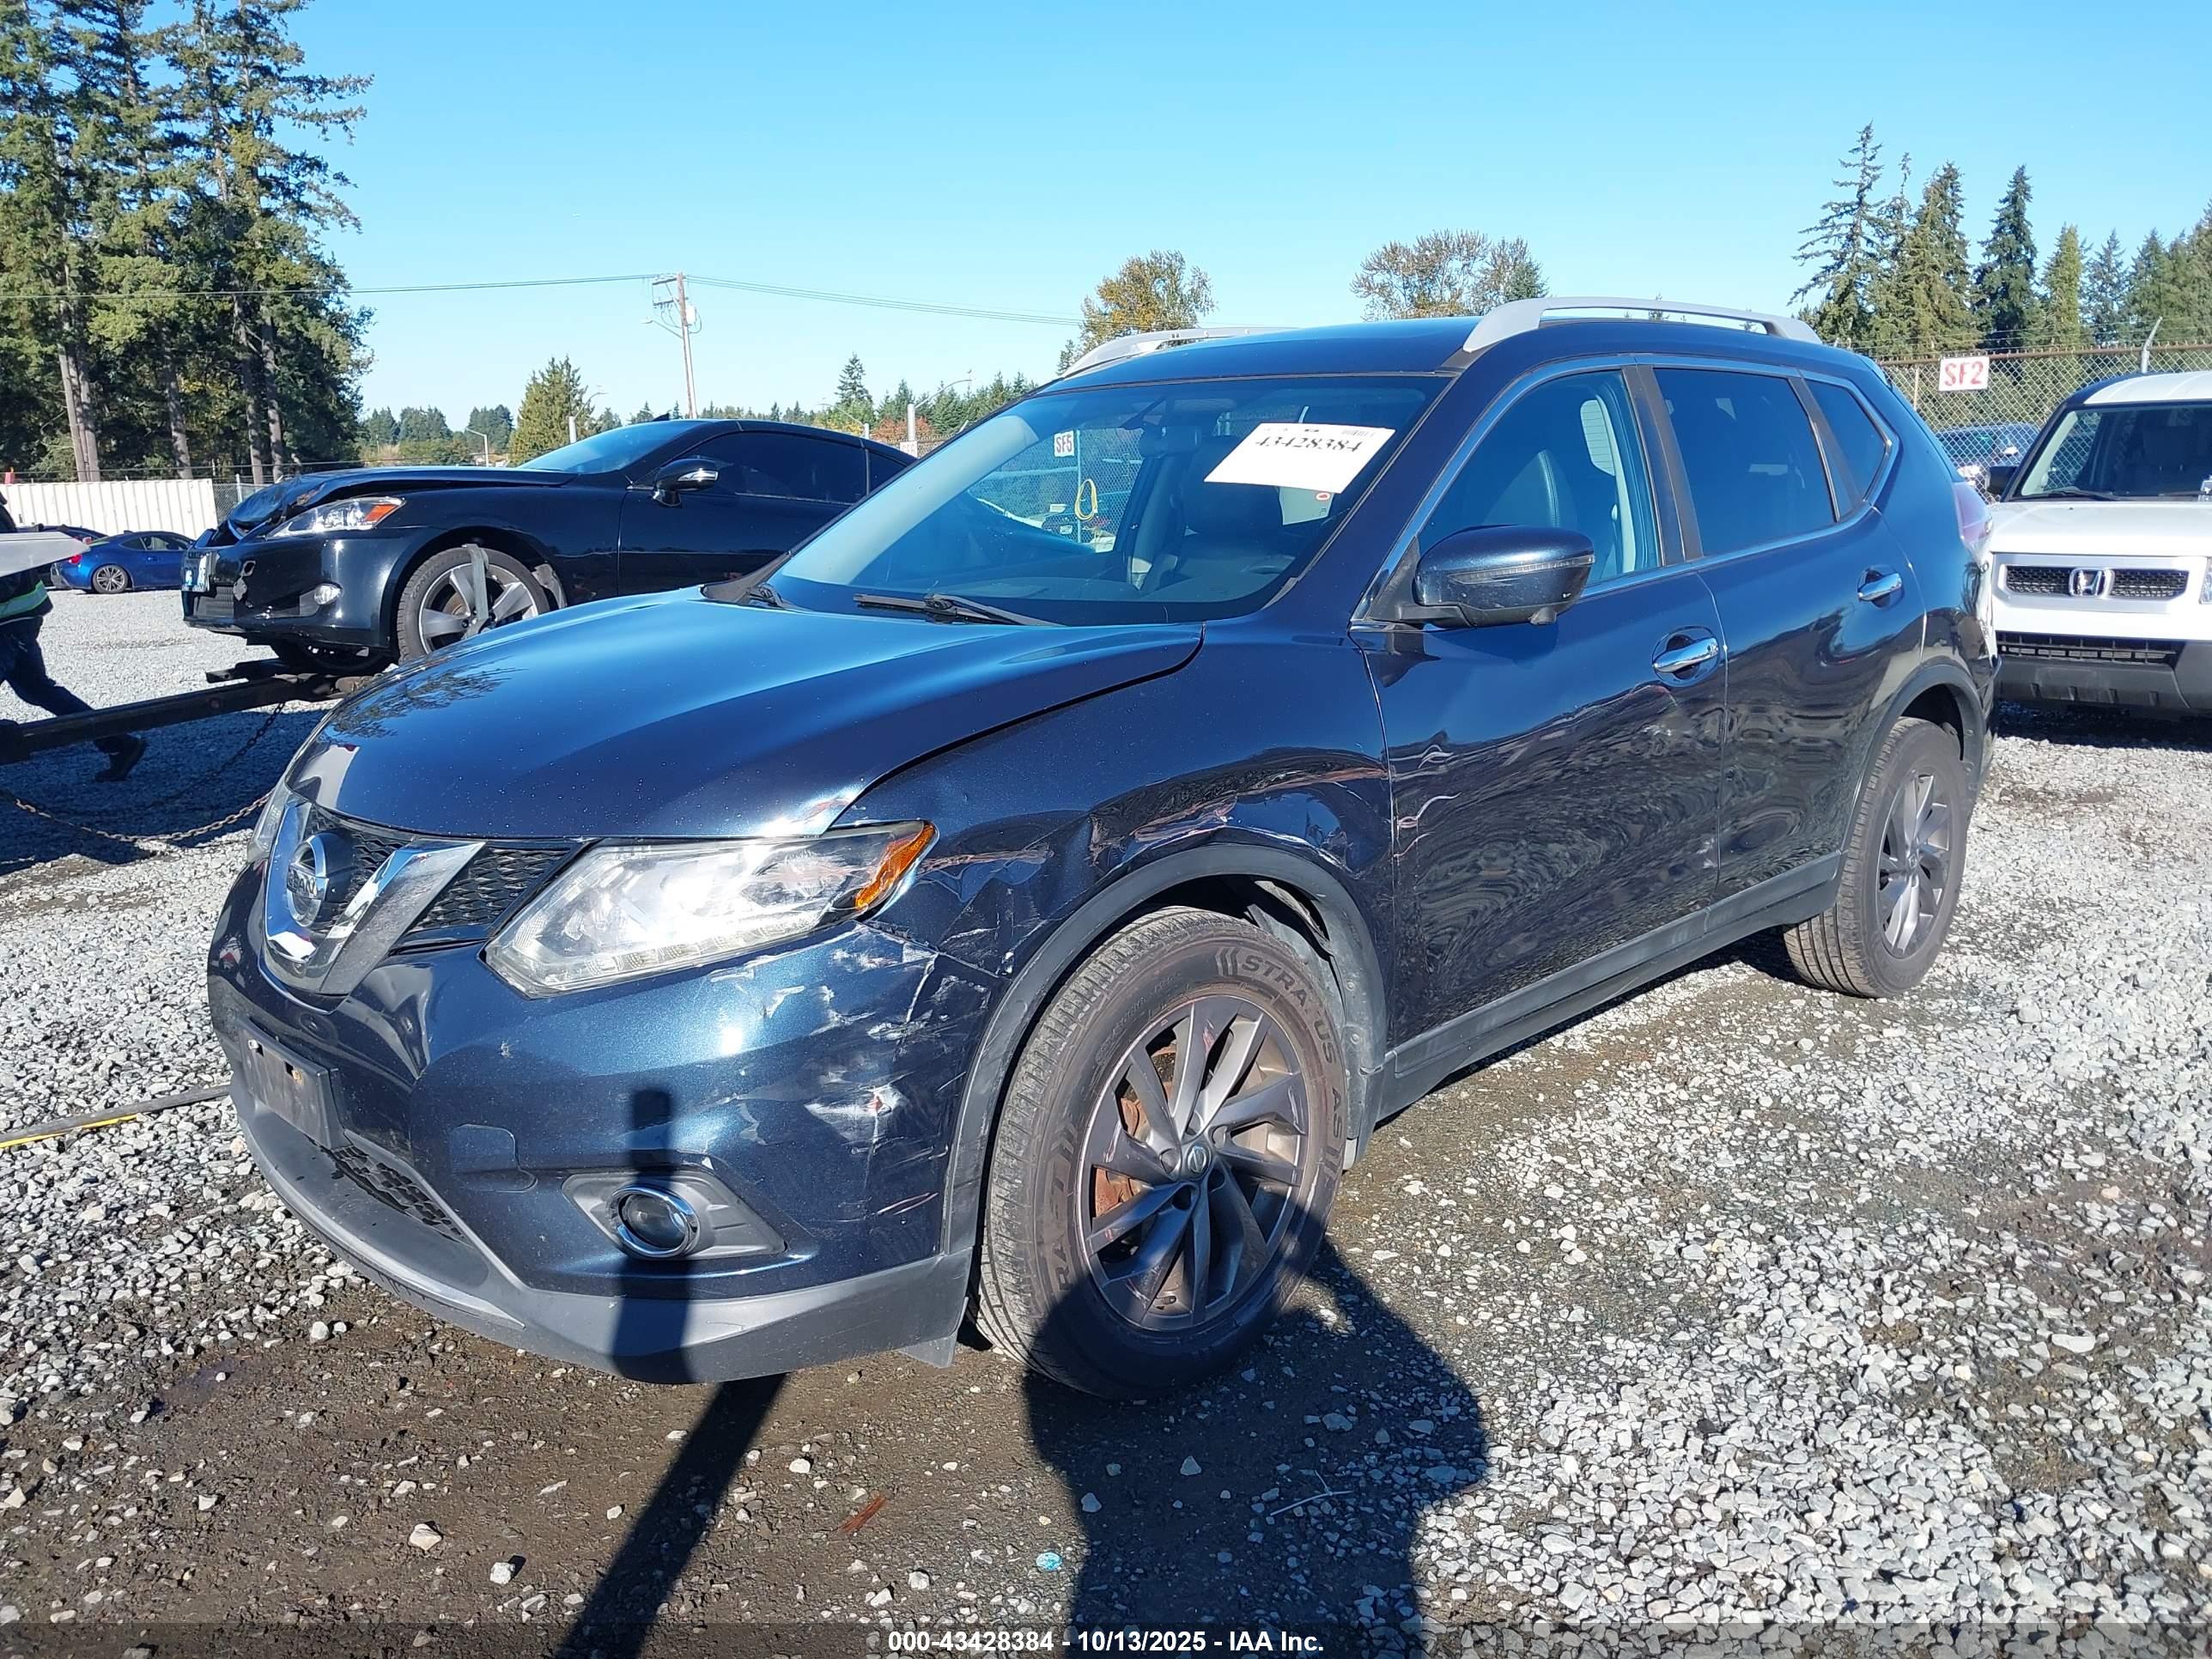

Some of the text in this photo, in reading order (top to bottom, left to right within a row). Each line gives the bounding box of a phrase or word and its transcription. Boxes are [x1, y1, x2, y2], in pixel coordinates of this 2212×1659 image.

[1944, 361, 1984, 386] SF2
[1056, 434, 1073, 453] SF5
[1255, 436, 1363, 452] 43428384
[1242, 955, 1337, 1063] STRAUS
